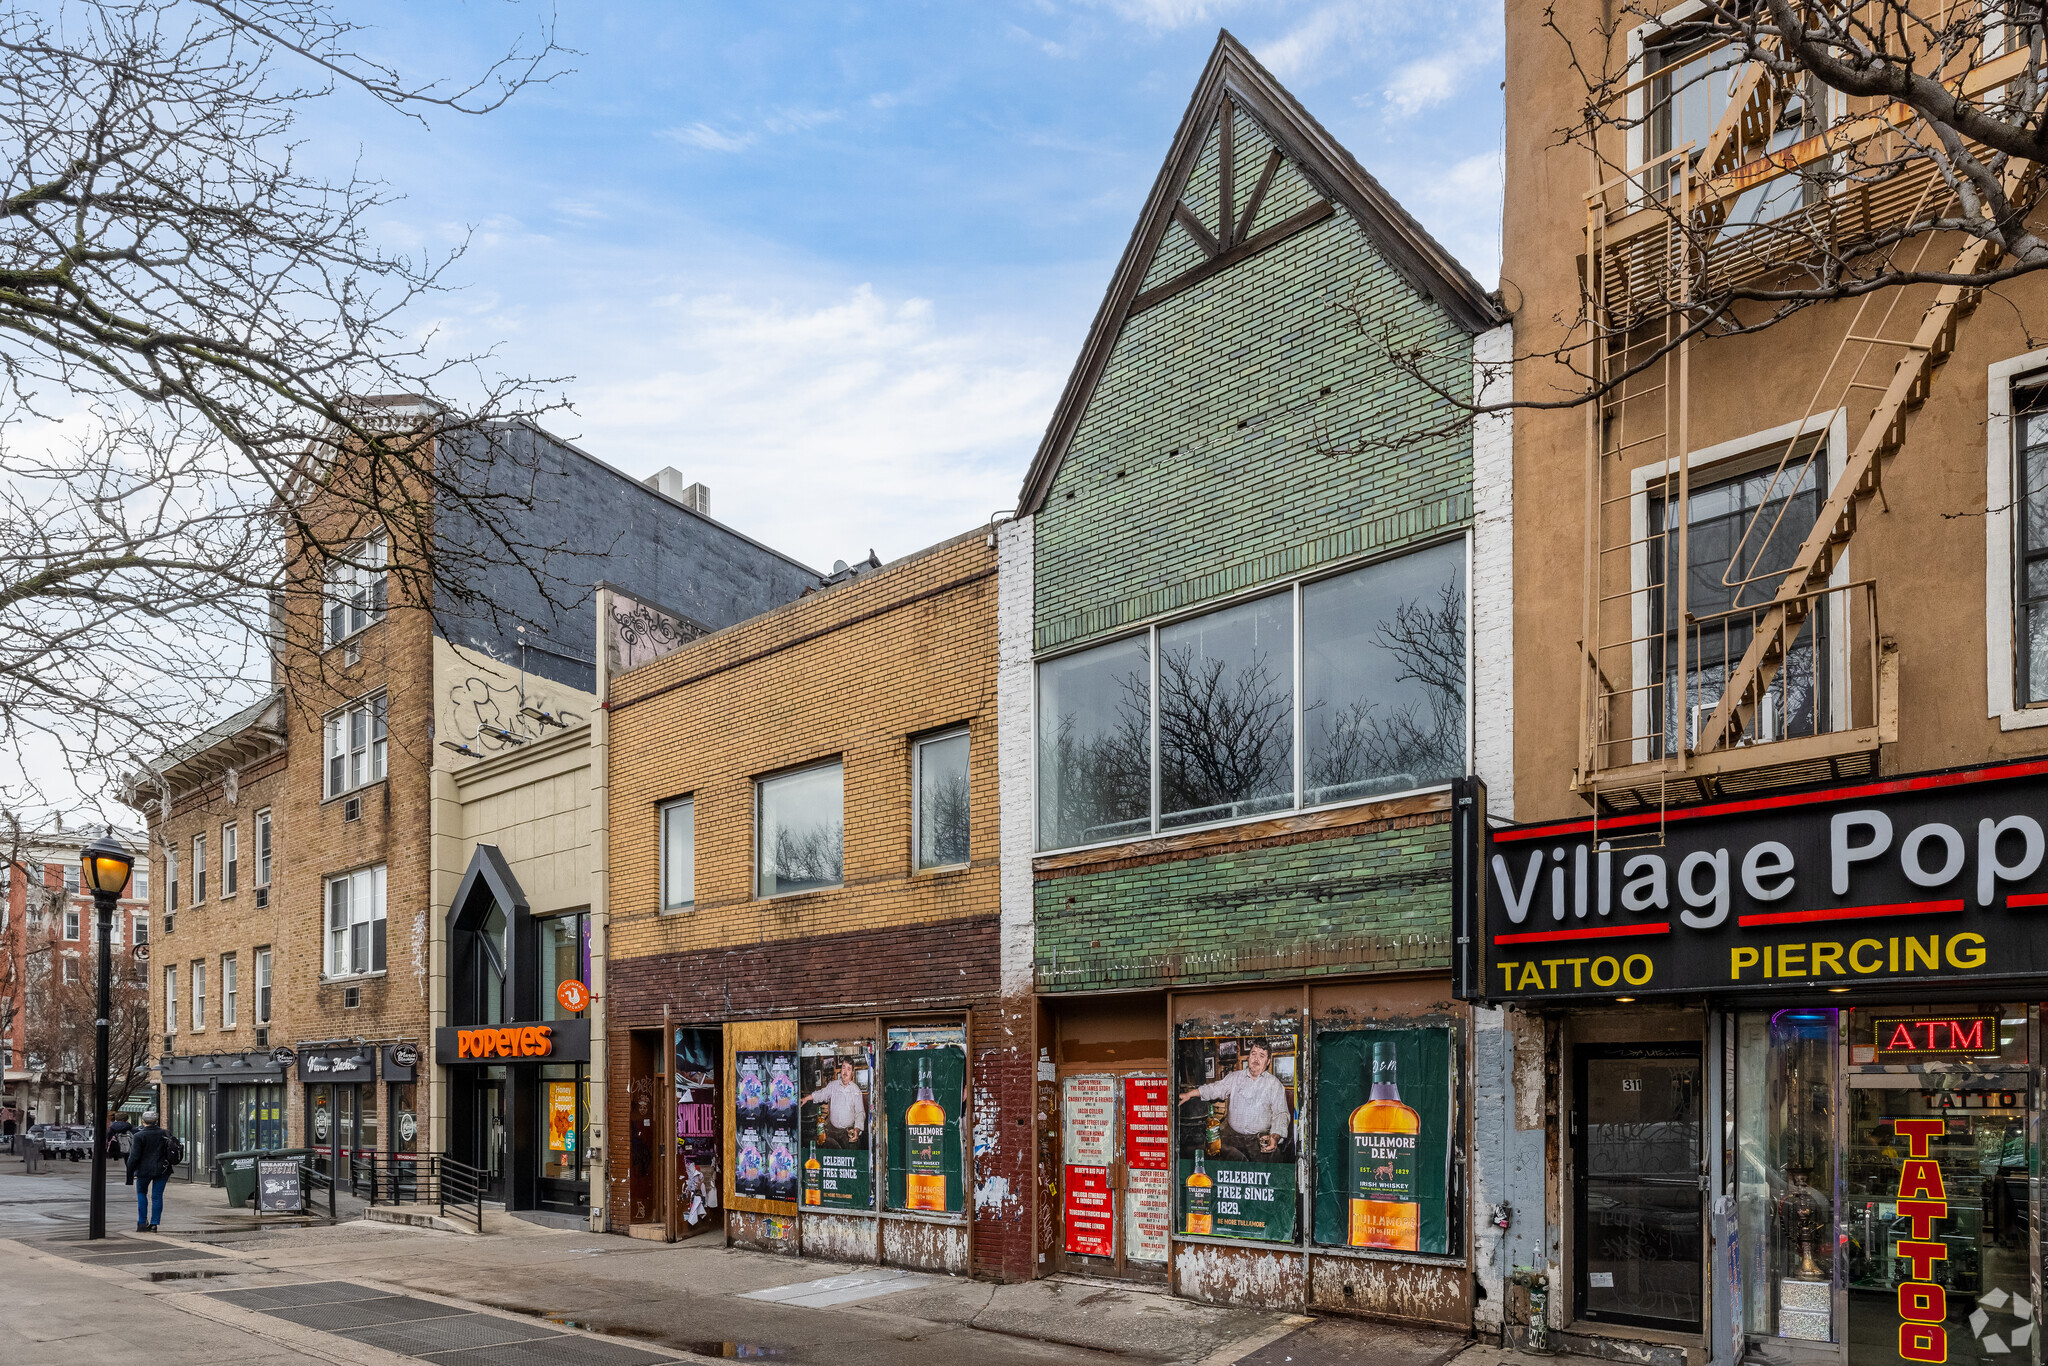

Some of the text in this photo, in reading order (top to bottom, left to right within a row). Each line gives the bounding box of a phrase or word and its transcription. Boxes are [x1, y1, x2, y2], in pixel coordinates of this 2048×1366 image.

[1491, 809, 2046, 929] Village Pop
[1497, 932, 1987, 991] TATTOO PIERCING
[1886, 1020, 1983, 1050] ATM
[556, 1086, 571, 1094] Honey
[1624, 1080, 1642, 1090] 311
[555, 1094, 572, 1102] Lemon
[555, 1102, 572, 1112] Pepper
[678, 1104, 713, 1134] SPIKE LEE
[909, 1127, 943, 1136] TULLAMORE
[1355, 1136, 1415, 1148] TULLAMORE
[1371, 1148, 1398, 1159] D.E.W.
[823, 1156, 855, 1167] CELEBRITY
[261, 1166, 296, 1174] SPECIAL
[823, 1168, 857, 1179] FREE SINCE
[1217, 1170, 1271, 1185] CELEBRITY
[823, 1180, 838, 1190] 1829.
[1217, 1186, 1274, 1201] FREE SINCE
[1217, 1202, 1241, 1215] 1829.
[1237, 1219, 1265, 1228] TULLAMORE
[1353, 1213, 1416, 1228] TULLAMORE
[1354, 1225, 1375, 1234] HEART
[1384, 1228, 1415, 1236] IRELAND
[1894, 1119, 1948, 1364] TATTOO
